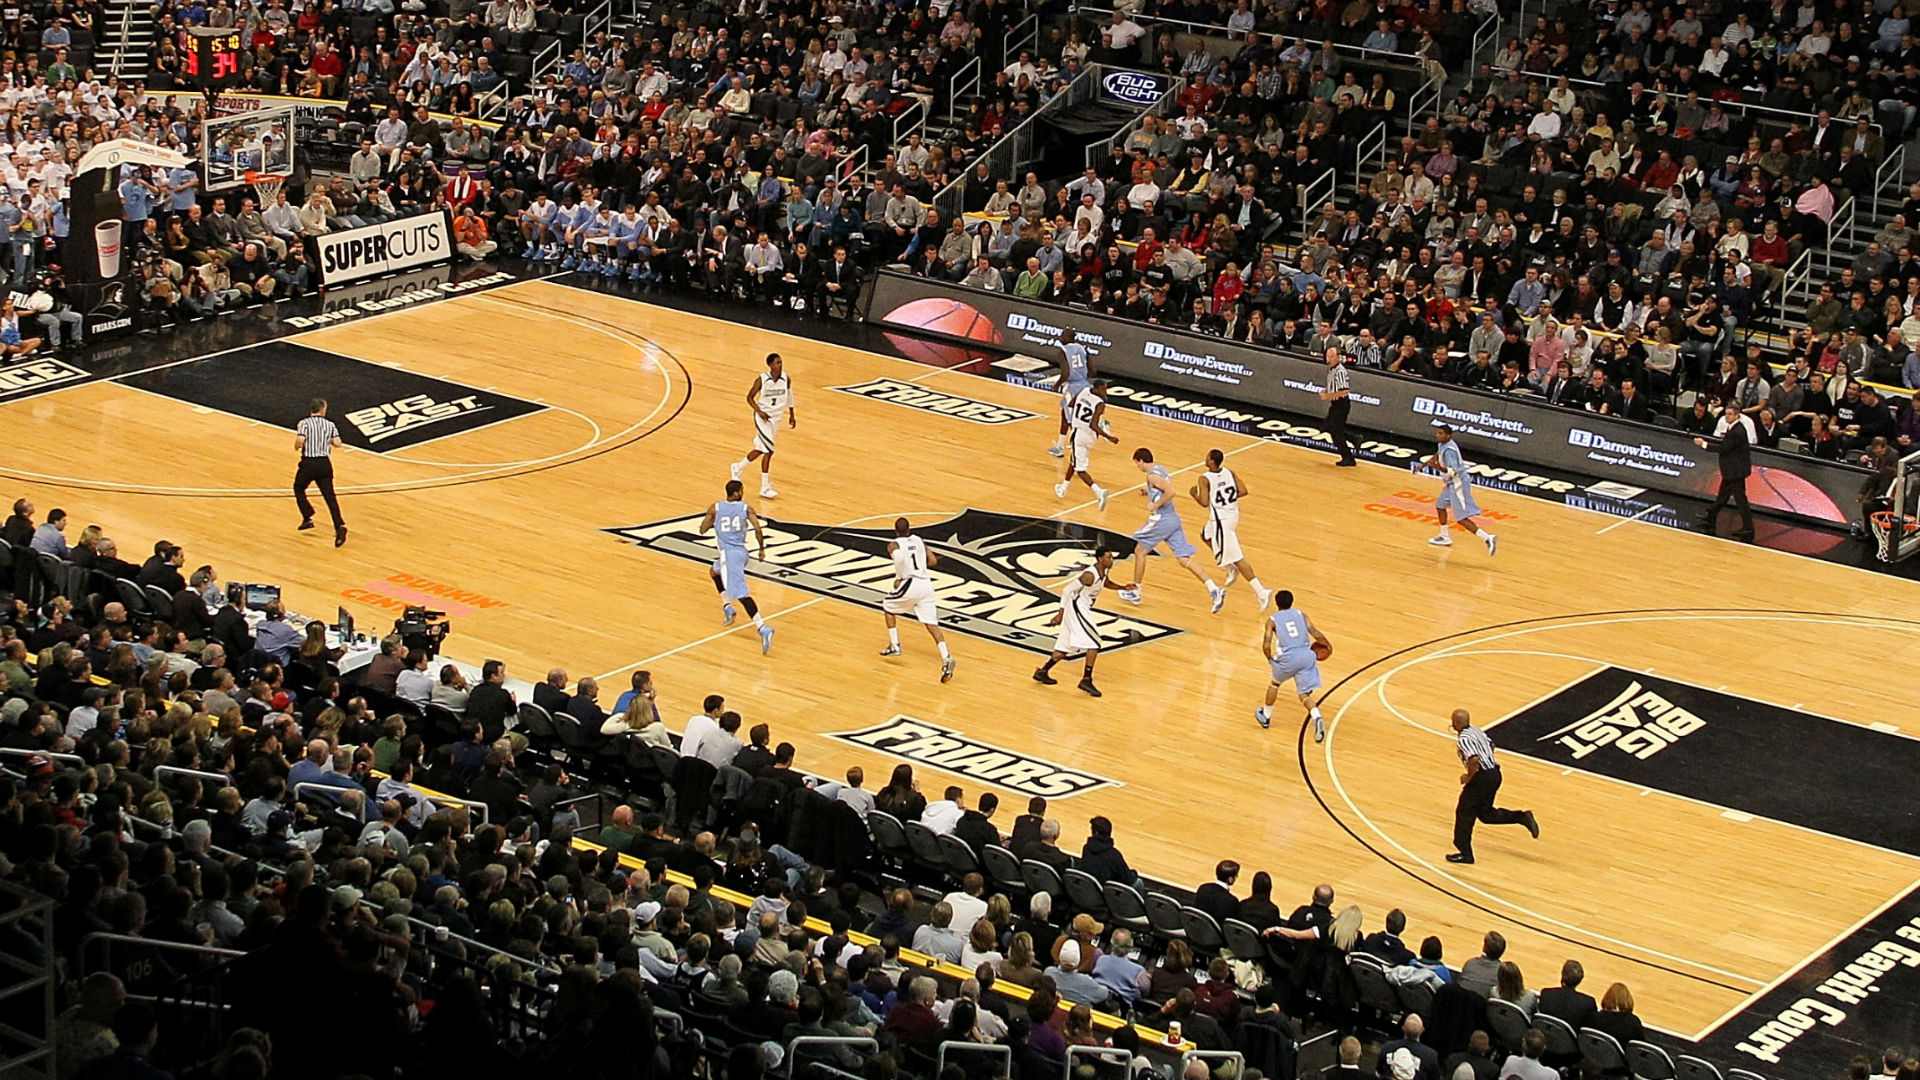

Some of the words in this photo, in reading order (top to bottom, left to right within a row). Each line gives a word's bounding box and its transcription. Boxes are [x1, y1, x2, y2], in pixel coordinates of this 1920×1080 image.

[212, 52, 238, 78] 34
[1109, 83, 1163, 100] LIGHT
[1117, 75, 1156, 89] BUD
[214, 98, 261, 110] SPORTS
[324, 223, 441, 275] SUPERCUTS
[283, 307, 361, 329] Dave
[357, 287, 444, 313] Gavitt
[438, 271, 516, 295] Court
[1071, 354, 1083, 368] 21
[1163, 347, 1244, 374] DarrowEverett
[345, 393, 435, 426] BIG
[844, 379, 1030, 424] FRIARS
[1075, 402, 1093, 423] 12
[1434, 402, 1523, 433] DarrowEverett
[1591, 434, 1685, 466] DarrowEverett
[1215, 486, 1237, 506] 42
[720, 516, 742, 532] 24
[911, 553, 919, 570] 1
[386, 573, 510, 609] DUNKIN'
[1285, 621, 1299, 638] 5
[1559, 690, 1676, 760] EAST
[1615, 706, 1708, 761] BIG
[849, 720, 1100, 798] FRIARS
[1815, 940, 1920, 1005] Gavitt
[1734, 997, 1847, 1064] Court
